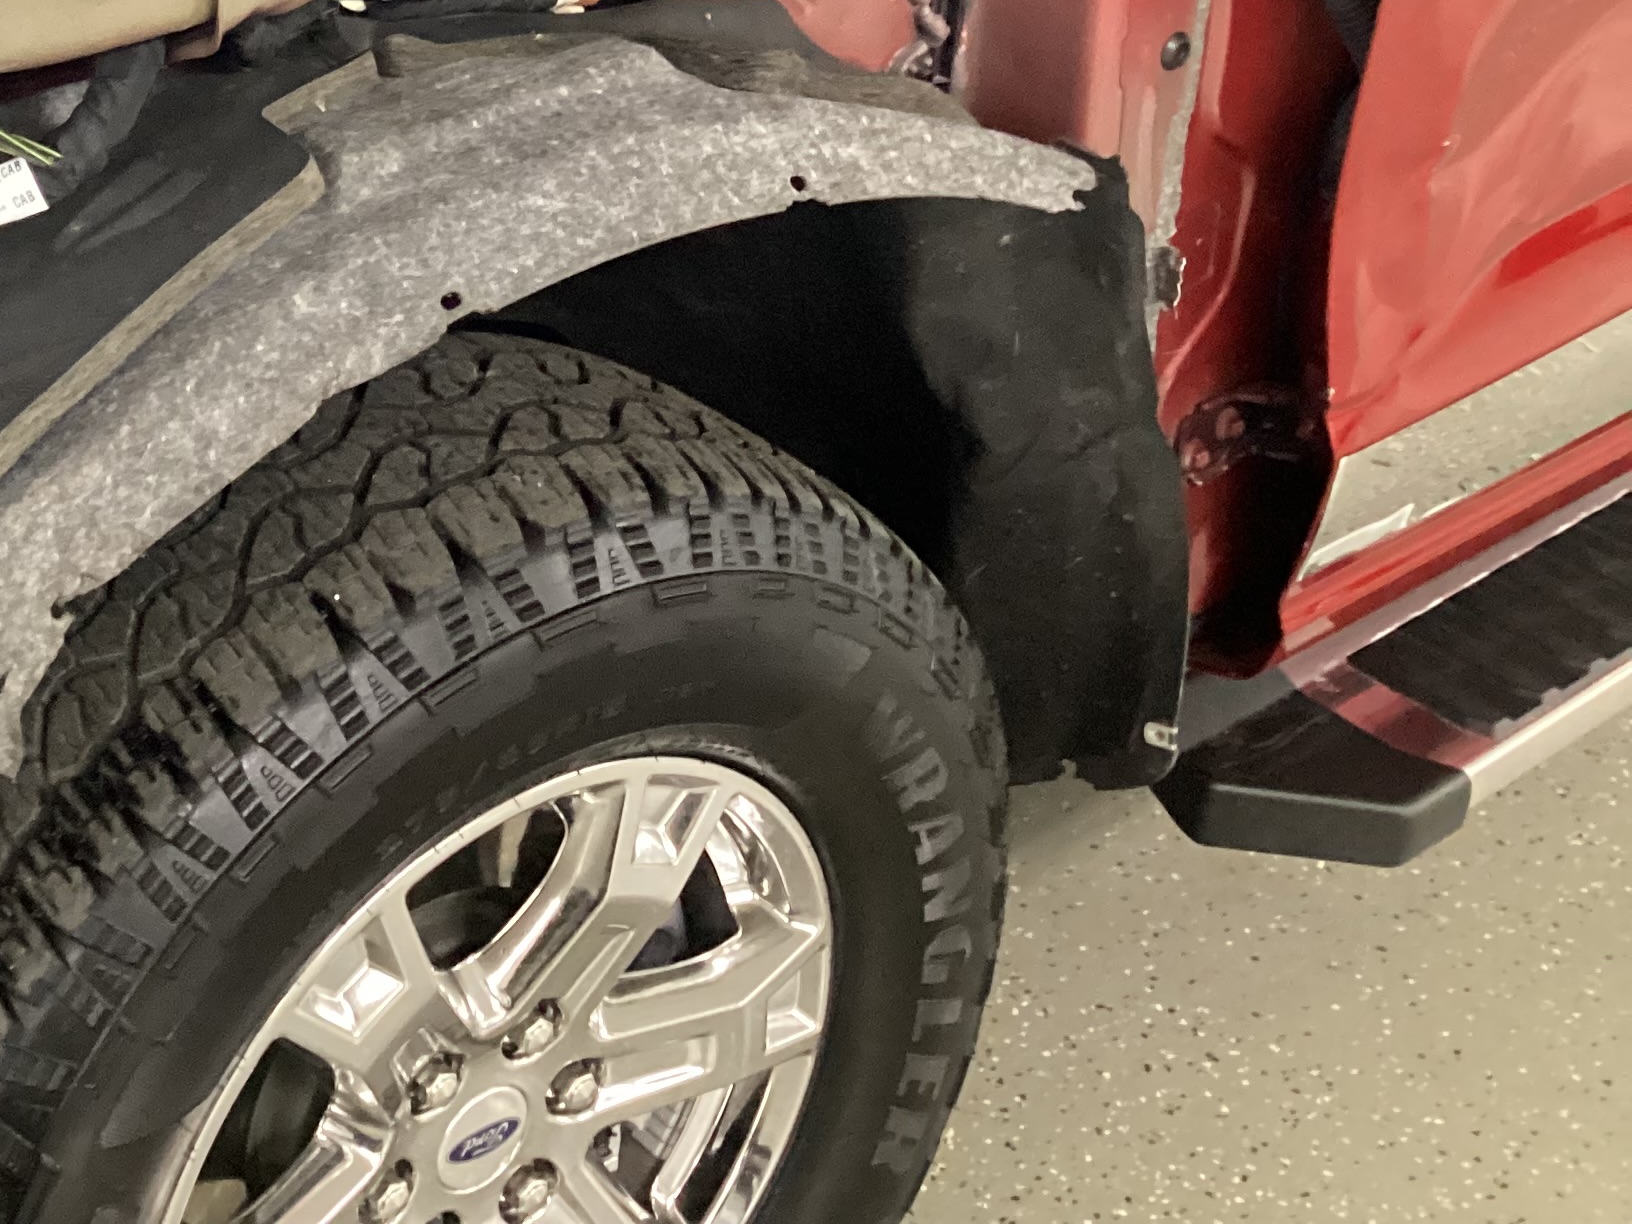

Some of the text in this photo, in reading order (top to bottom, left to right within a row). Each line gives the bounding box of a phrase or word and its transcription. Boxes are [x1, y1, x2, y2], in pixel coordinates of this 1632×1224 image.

[0, 160, 22, 178] CAB
[12, 189, 36, 209] CAB
[869, 692, 972, 1174] WRANGLER
[460, 1121, 510, 1159] Ford
